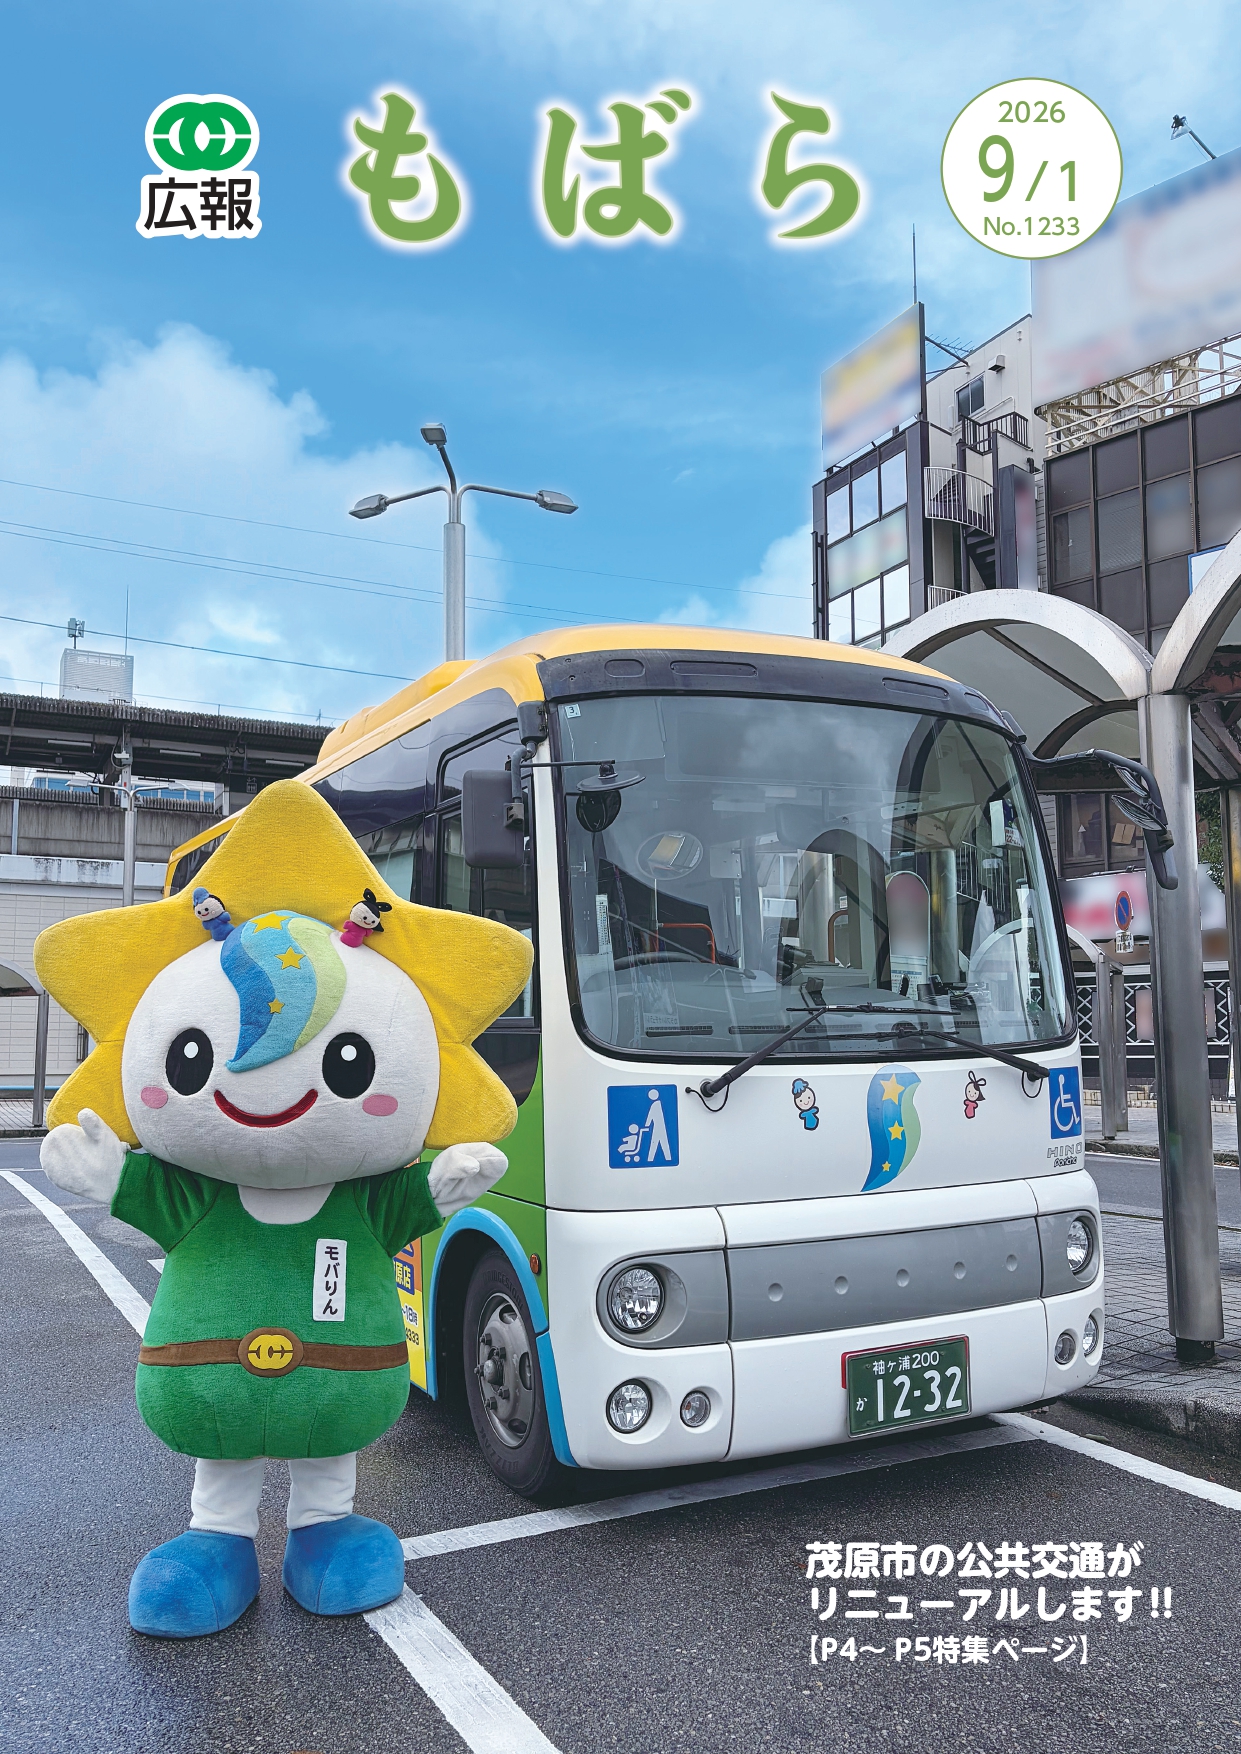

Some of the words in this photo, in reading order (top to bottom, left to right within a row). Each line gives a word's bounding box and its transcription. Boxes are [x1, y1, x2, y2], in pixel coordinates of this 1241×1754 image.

[1046, 1141, 1083, 1159] HINO
[322, 1245, 341, 1316] モバりん
[393, 1261, 412, 1290] 原店
[856, 1397, 868, 1412] か
[877, 1365, 963, 1422] 12-32
